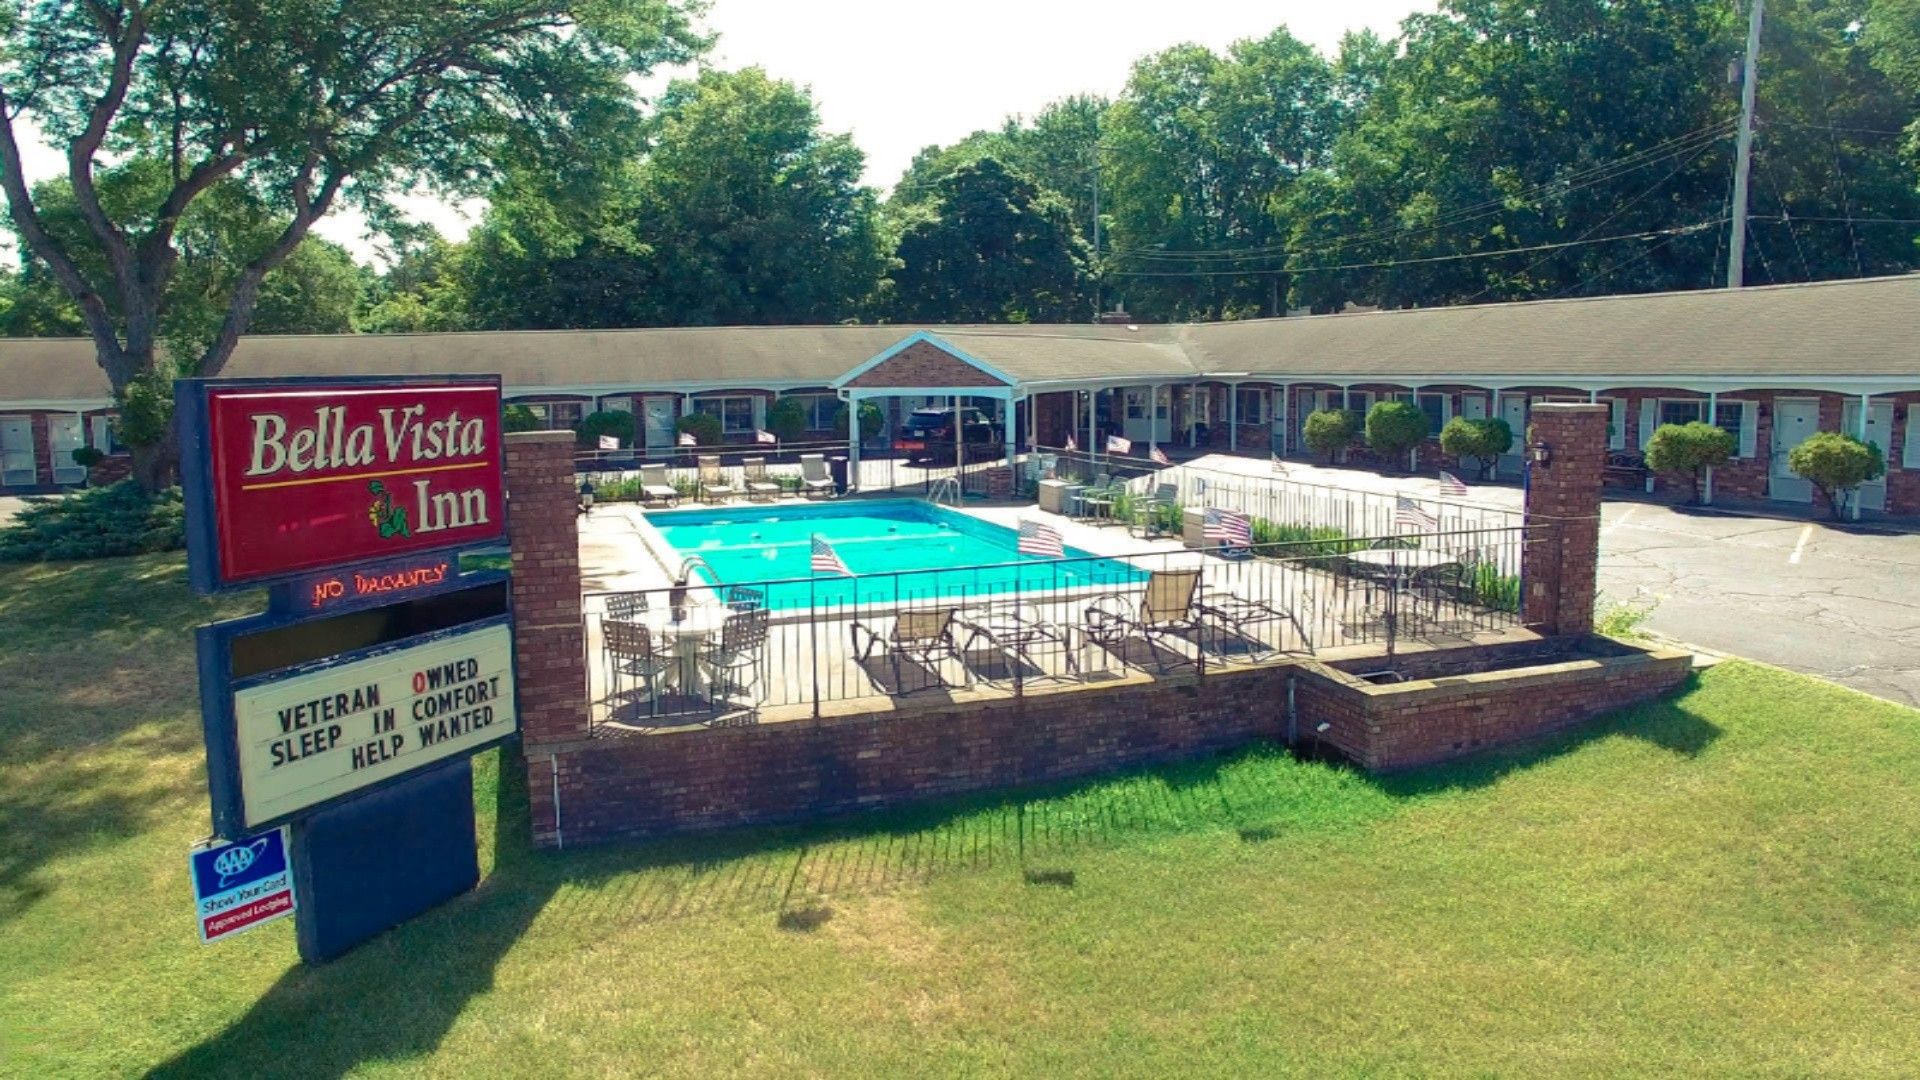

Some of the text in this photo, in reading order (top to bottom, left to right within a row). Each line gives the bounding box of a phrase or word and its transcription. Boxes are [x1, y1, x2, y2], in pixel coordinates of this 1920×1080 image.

[245, 404, 486, 476] Bella Vista
[413, 479, 490, 533] Inn
[311, 563, 448, 608] NO VACANCY
[270, 677, 499, 768] SLEEP IN COMFORT
[278, 658, 478, 733] VETERAN OWNED
[352, 705, 493, 770] HELP WANTED
[216, 848, 253, 874] AAA
[203, 874, 287, 914] Show Your Card
[208, 896, 290, 932] Approved Lodging
